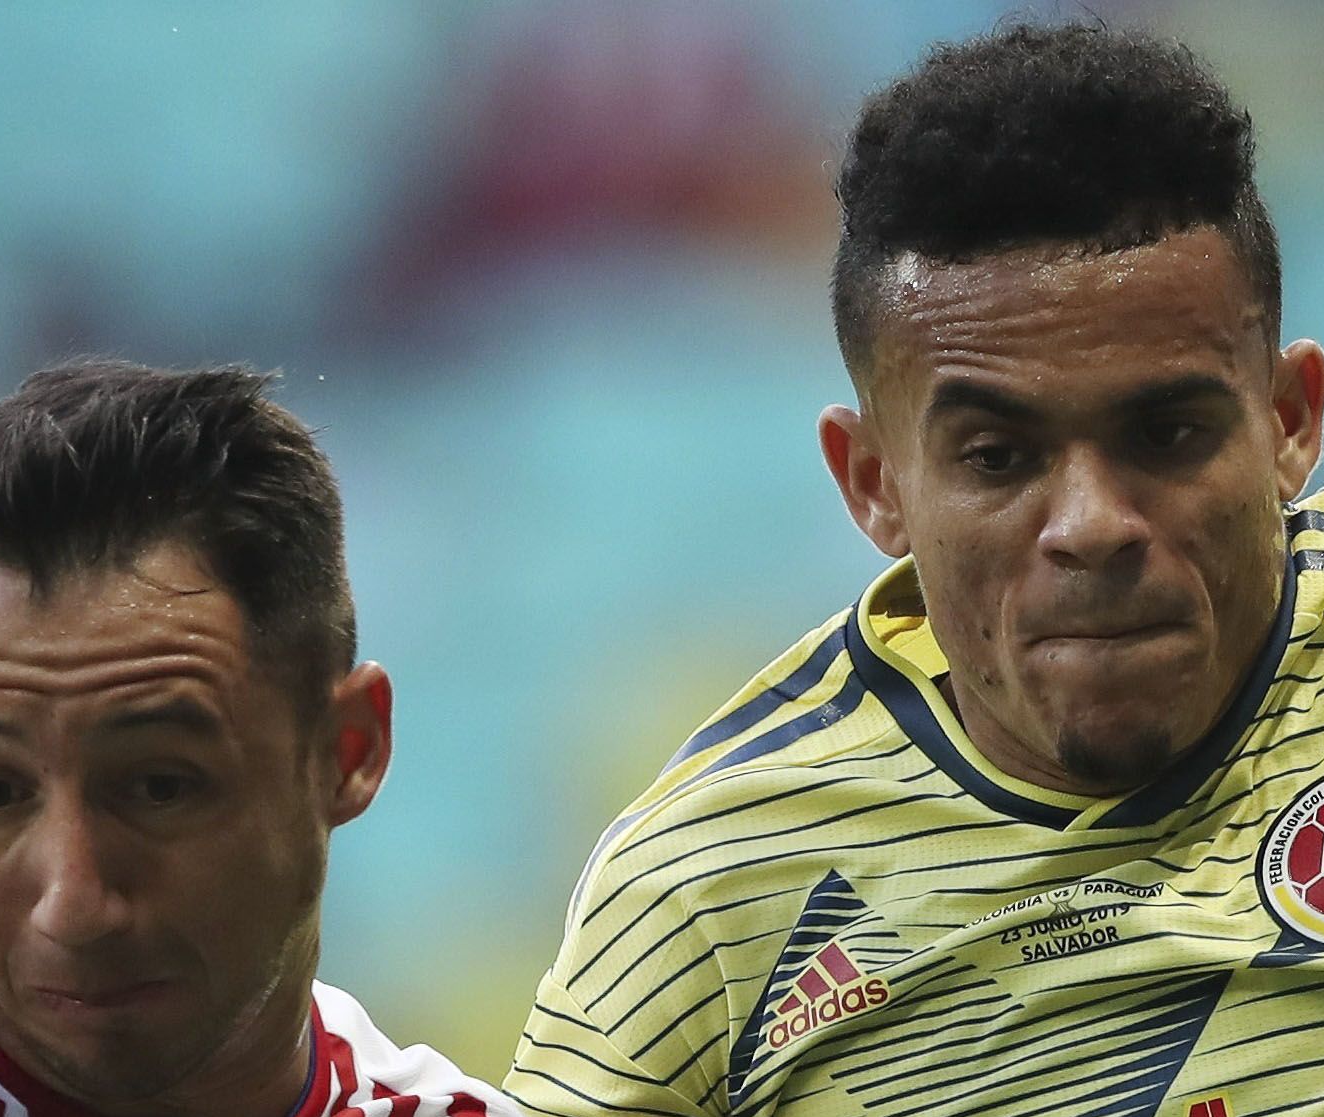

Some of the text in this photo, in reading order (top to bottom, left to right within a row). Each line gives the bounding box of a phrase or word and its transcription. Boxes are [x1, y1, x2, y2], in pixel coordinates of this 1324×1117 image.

[1268, 809, 1306, 886] FEDERACION
[1084, 881, 1165, 899] PARAGUAY
[1000, 904, 1132, 946] 23 JUNIO 2019
[1020, 925, 1120, 962] SALVADOR
[768, 978, 889, 1049] adidas
